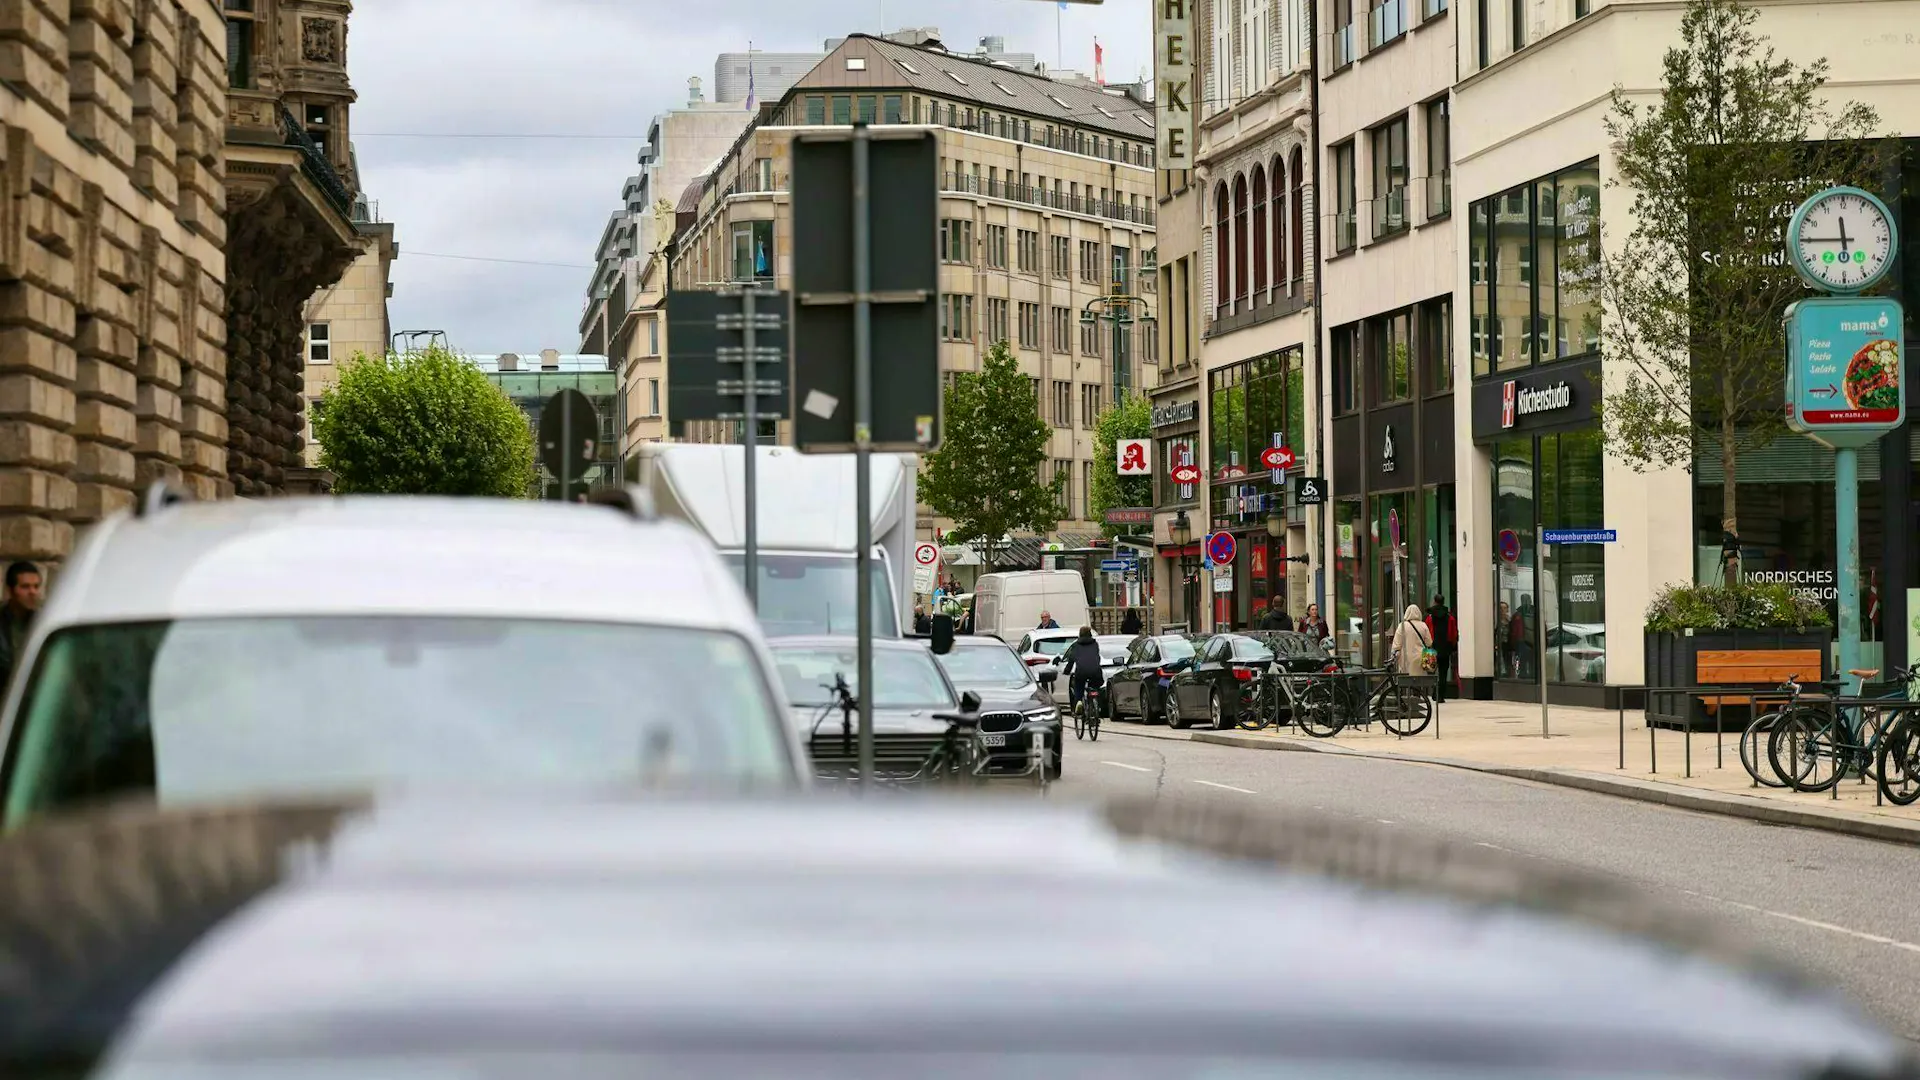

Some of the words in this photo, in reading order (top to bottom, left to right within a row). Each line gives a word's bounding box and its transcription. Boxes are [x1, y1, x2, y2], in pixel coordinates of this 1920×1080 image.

[1840, 202, 1847, 210] 12
[1810, 220, 1818, 228] 10
[1841, 321, 1877, 331] mama
[1808, 340, 1831, 349] Pizza
[1808, 352, 1832, 361] Pasta
[1809, 364, 1836, 374] Salate
[1518, 381, 1570, 415] Küchenstudio
[1545, 532, 1615, 543] Schauenburgerstraße
[1744, 570, 1833, 584] NORDISCHES
[986, 736, 1005, 745] 5359
